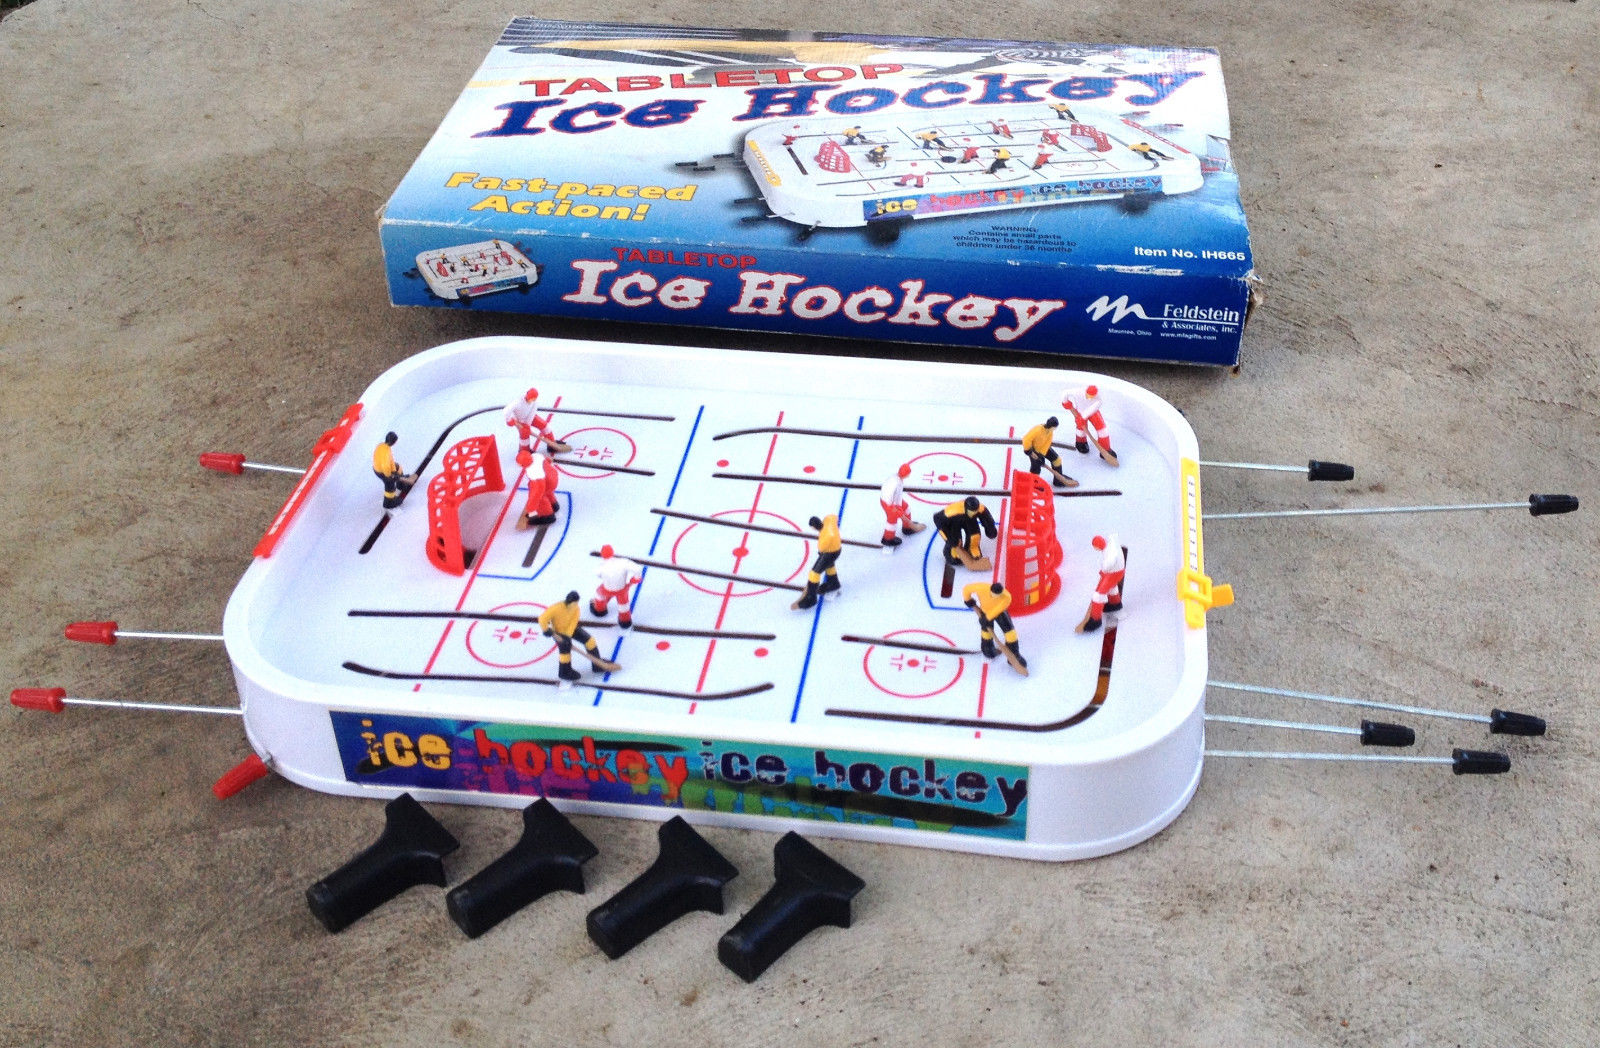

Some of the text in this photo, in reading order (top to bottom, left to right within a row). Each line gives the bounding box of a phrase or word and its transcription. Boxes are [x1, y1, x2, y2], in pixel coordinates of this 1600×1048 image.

[519, 64, 904, 97] TABLETOP
[470, 72, 1204, 139] Ice Hockey
[444, 171, 698, 202] Fast-paced
[468, 194, 651, 221] Action!
[612, 247, 758, 270] TABLETOP
[1134, 246, 1246, 261] Item No. IH665
[562, 258, 1067, 342] Ice Hockey
[1163, 303, 1240, 322] Feldstein
[1161, 321, 1169, 329] &
[1172, 321, 1219, 333] Associates,
[360, 719, 690, 807] ice hockey
[699, 740, 789, 787] ice
[813, 749, 1029, 818] hockey
